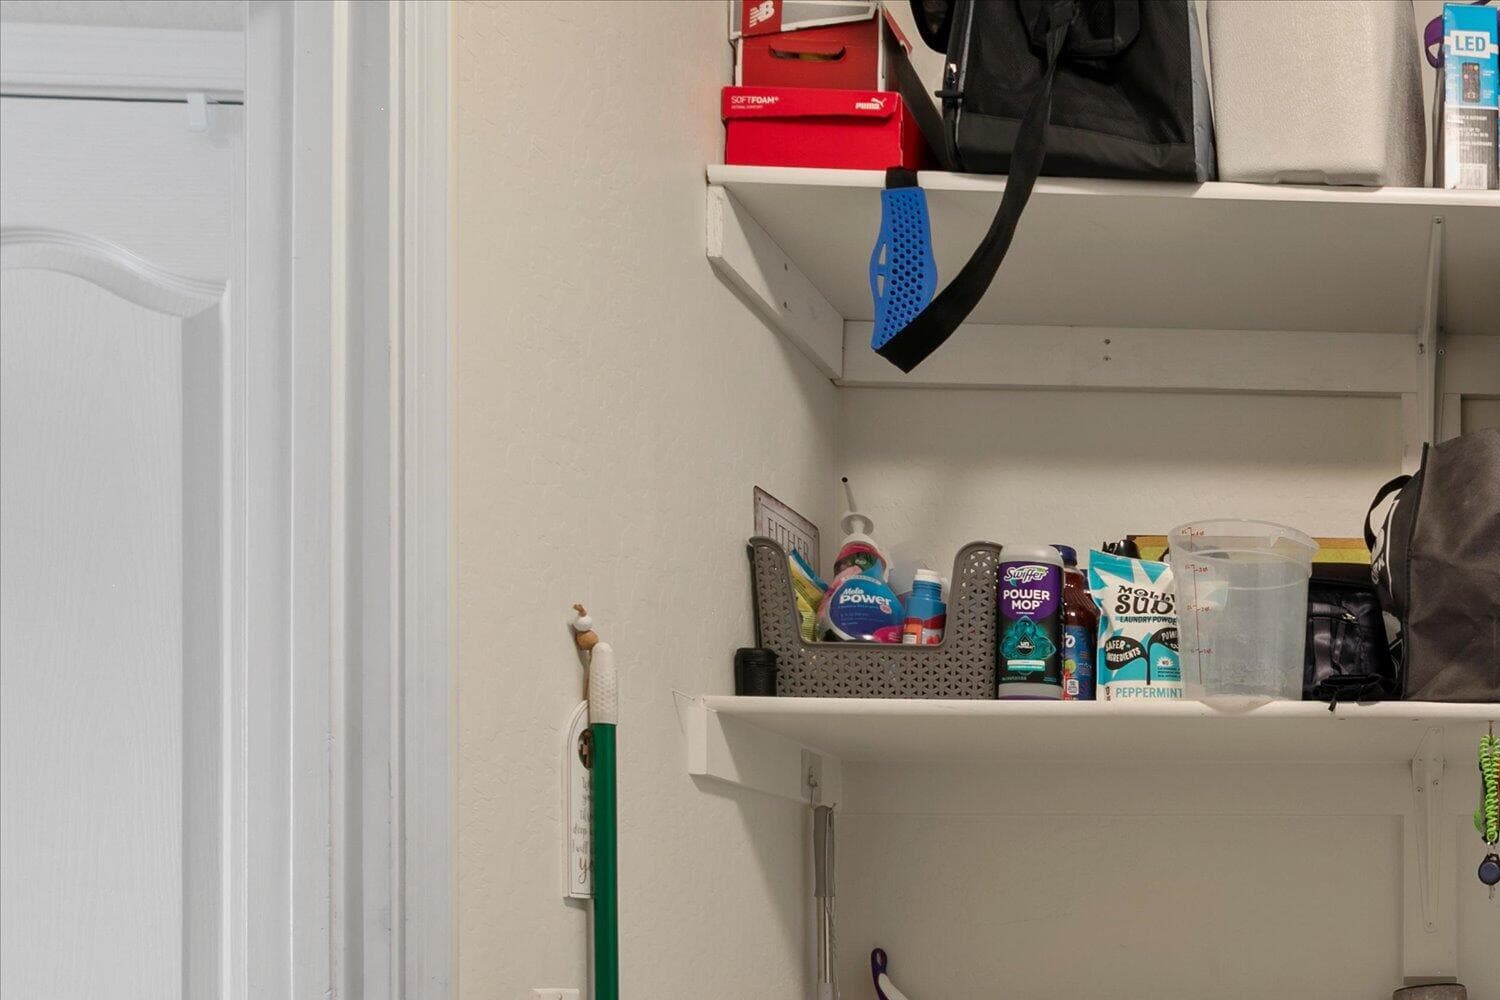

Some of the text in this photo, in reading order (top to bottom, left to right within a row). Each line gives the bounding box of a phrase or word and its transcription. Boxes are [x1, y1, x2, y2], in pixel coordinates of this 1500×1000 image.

[1455, 35, 1486, 52] LED
[1003, 566, 1048, 583] Swiffer
[1003, 589, 1050, 601] POWER
[1115, 593, 1177, 615] SUD
[1153, 616, 1178, 626] POWDE
